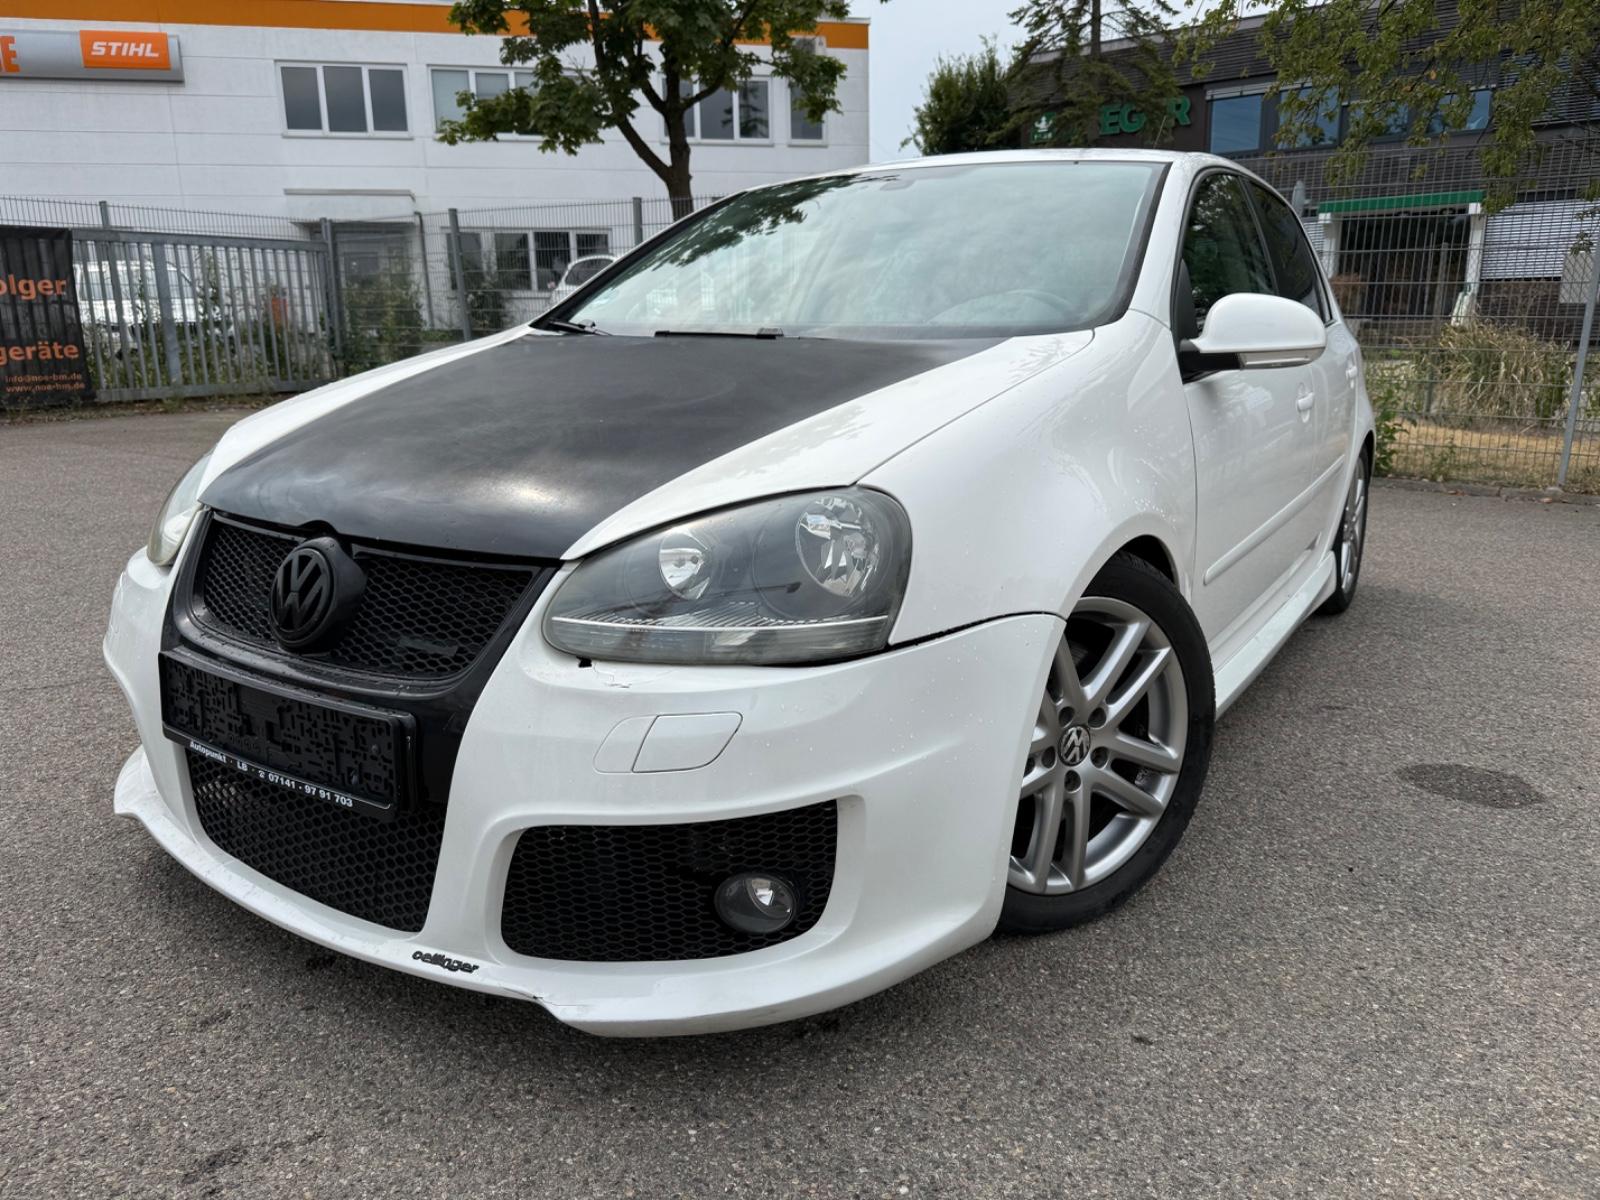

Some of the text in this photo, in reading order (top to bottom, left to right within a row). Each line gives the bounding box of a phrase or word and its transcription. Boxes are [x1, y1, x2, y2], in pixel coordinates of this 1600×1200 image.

[0, 36, 20, 73] E
[91, 41, 159, 57] STIHL
[190, 741, 227, 763] Autopunkt
[237, 760, 248, 772] LB
[268, 773, 296, 789] 07141
[304, 784, 317, 796] 97
[319, 789, 331, 800] 91
[334, 794, 353, 808] 703
